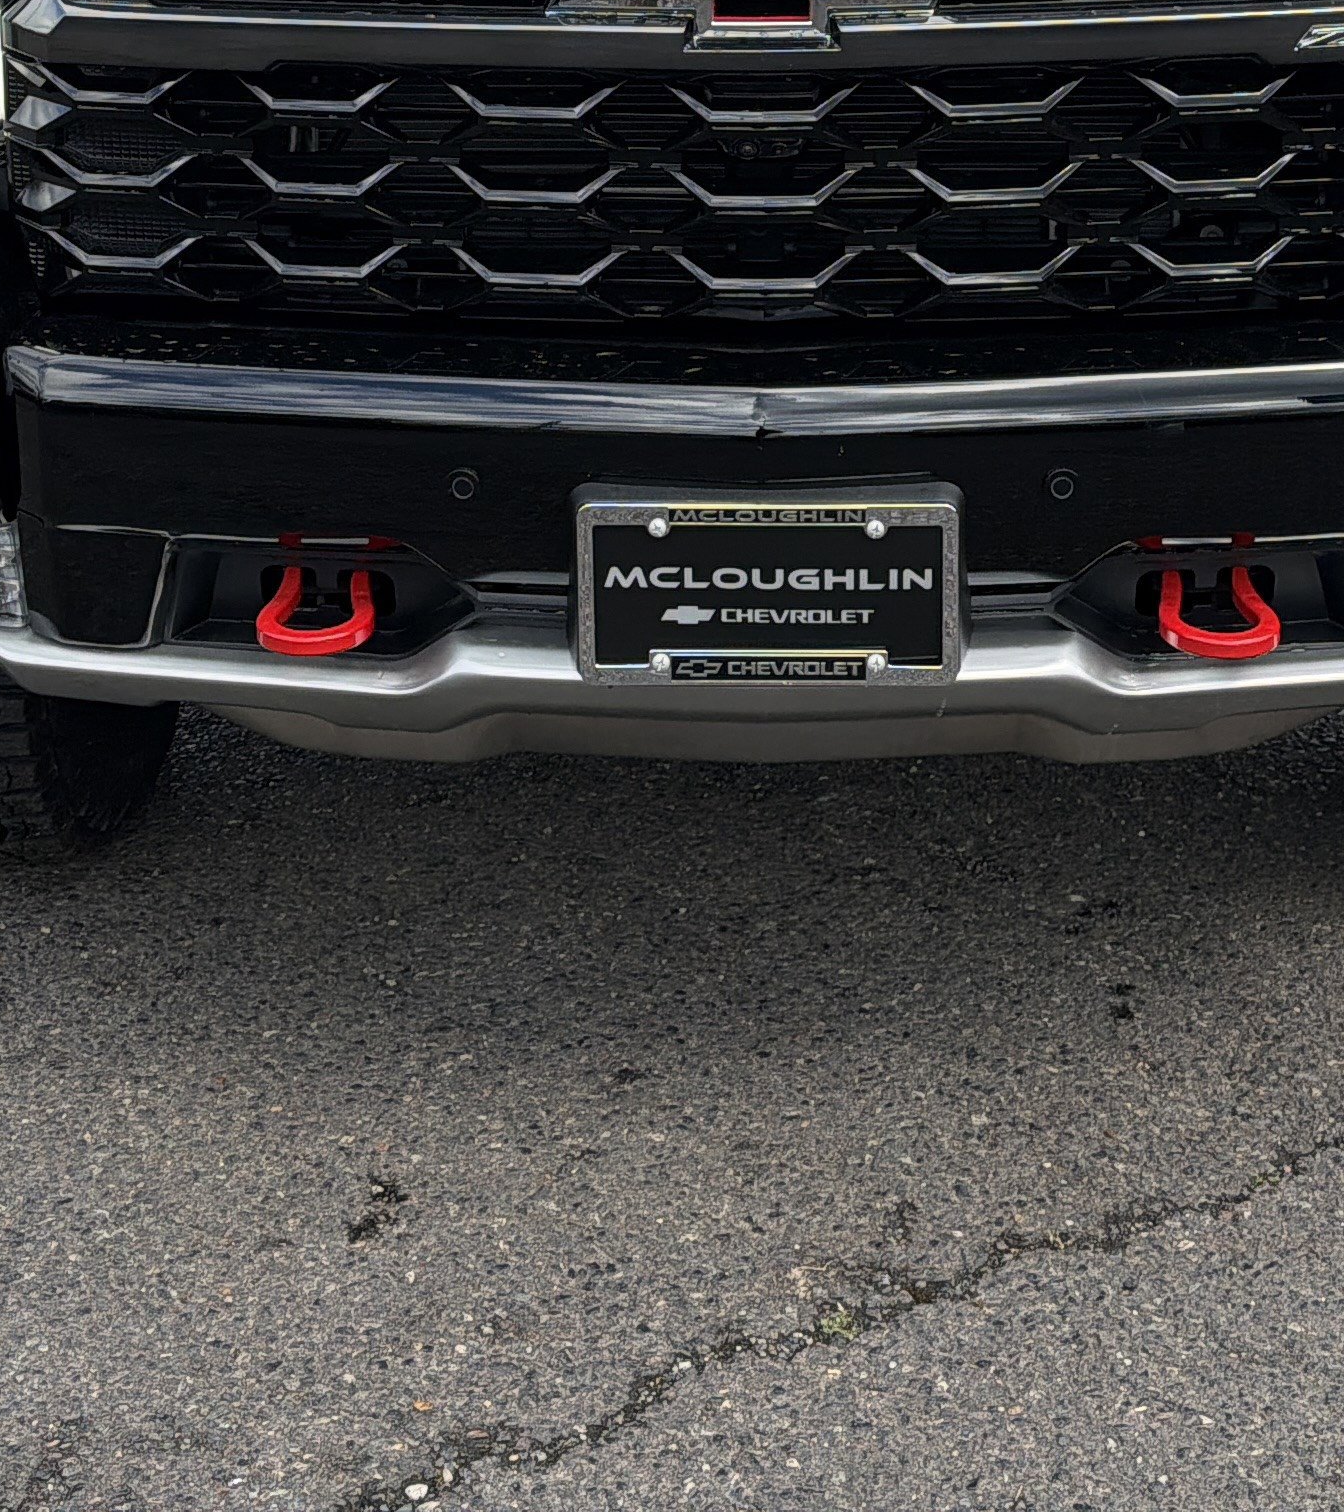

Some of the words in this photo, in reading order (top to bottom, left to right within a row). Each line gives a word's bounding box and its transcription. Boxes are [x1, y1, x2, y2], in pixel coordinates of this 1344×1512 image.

[672, 509, 864, 522] MCLOUGHLIN
[603, 566, 934, 591] MCLOUGHLIN
[720, 608, 875, 624] CHEVROLET
[727, 660, 864, 677] CHEVROLET
